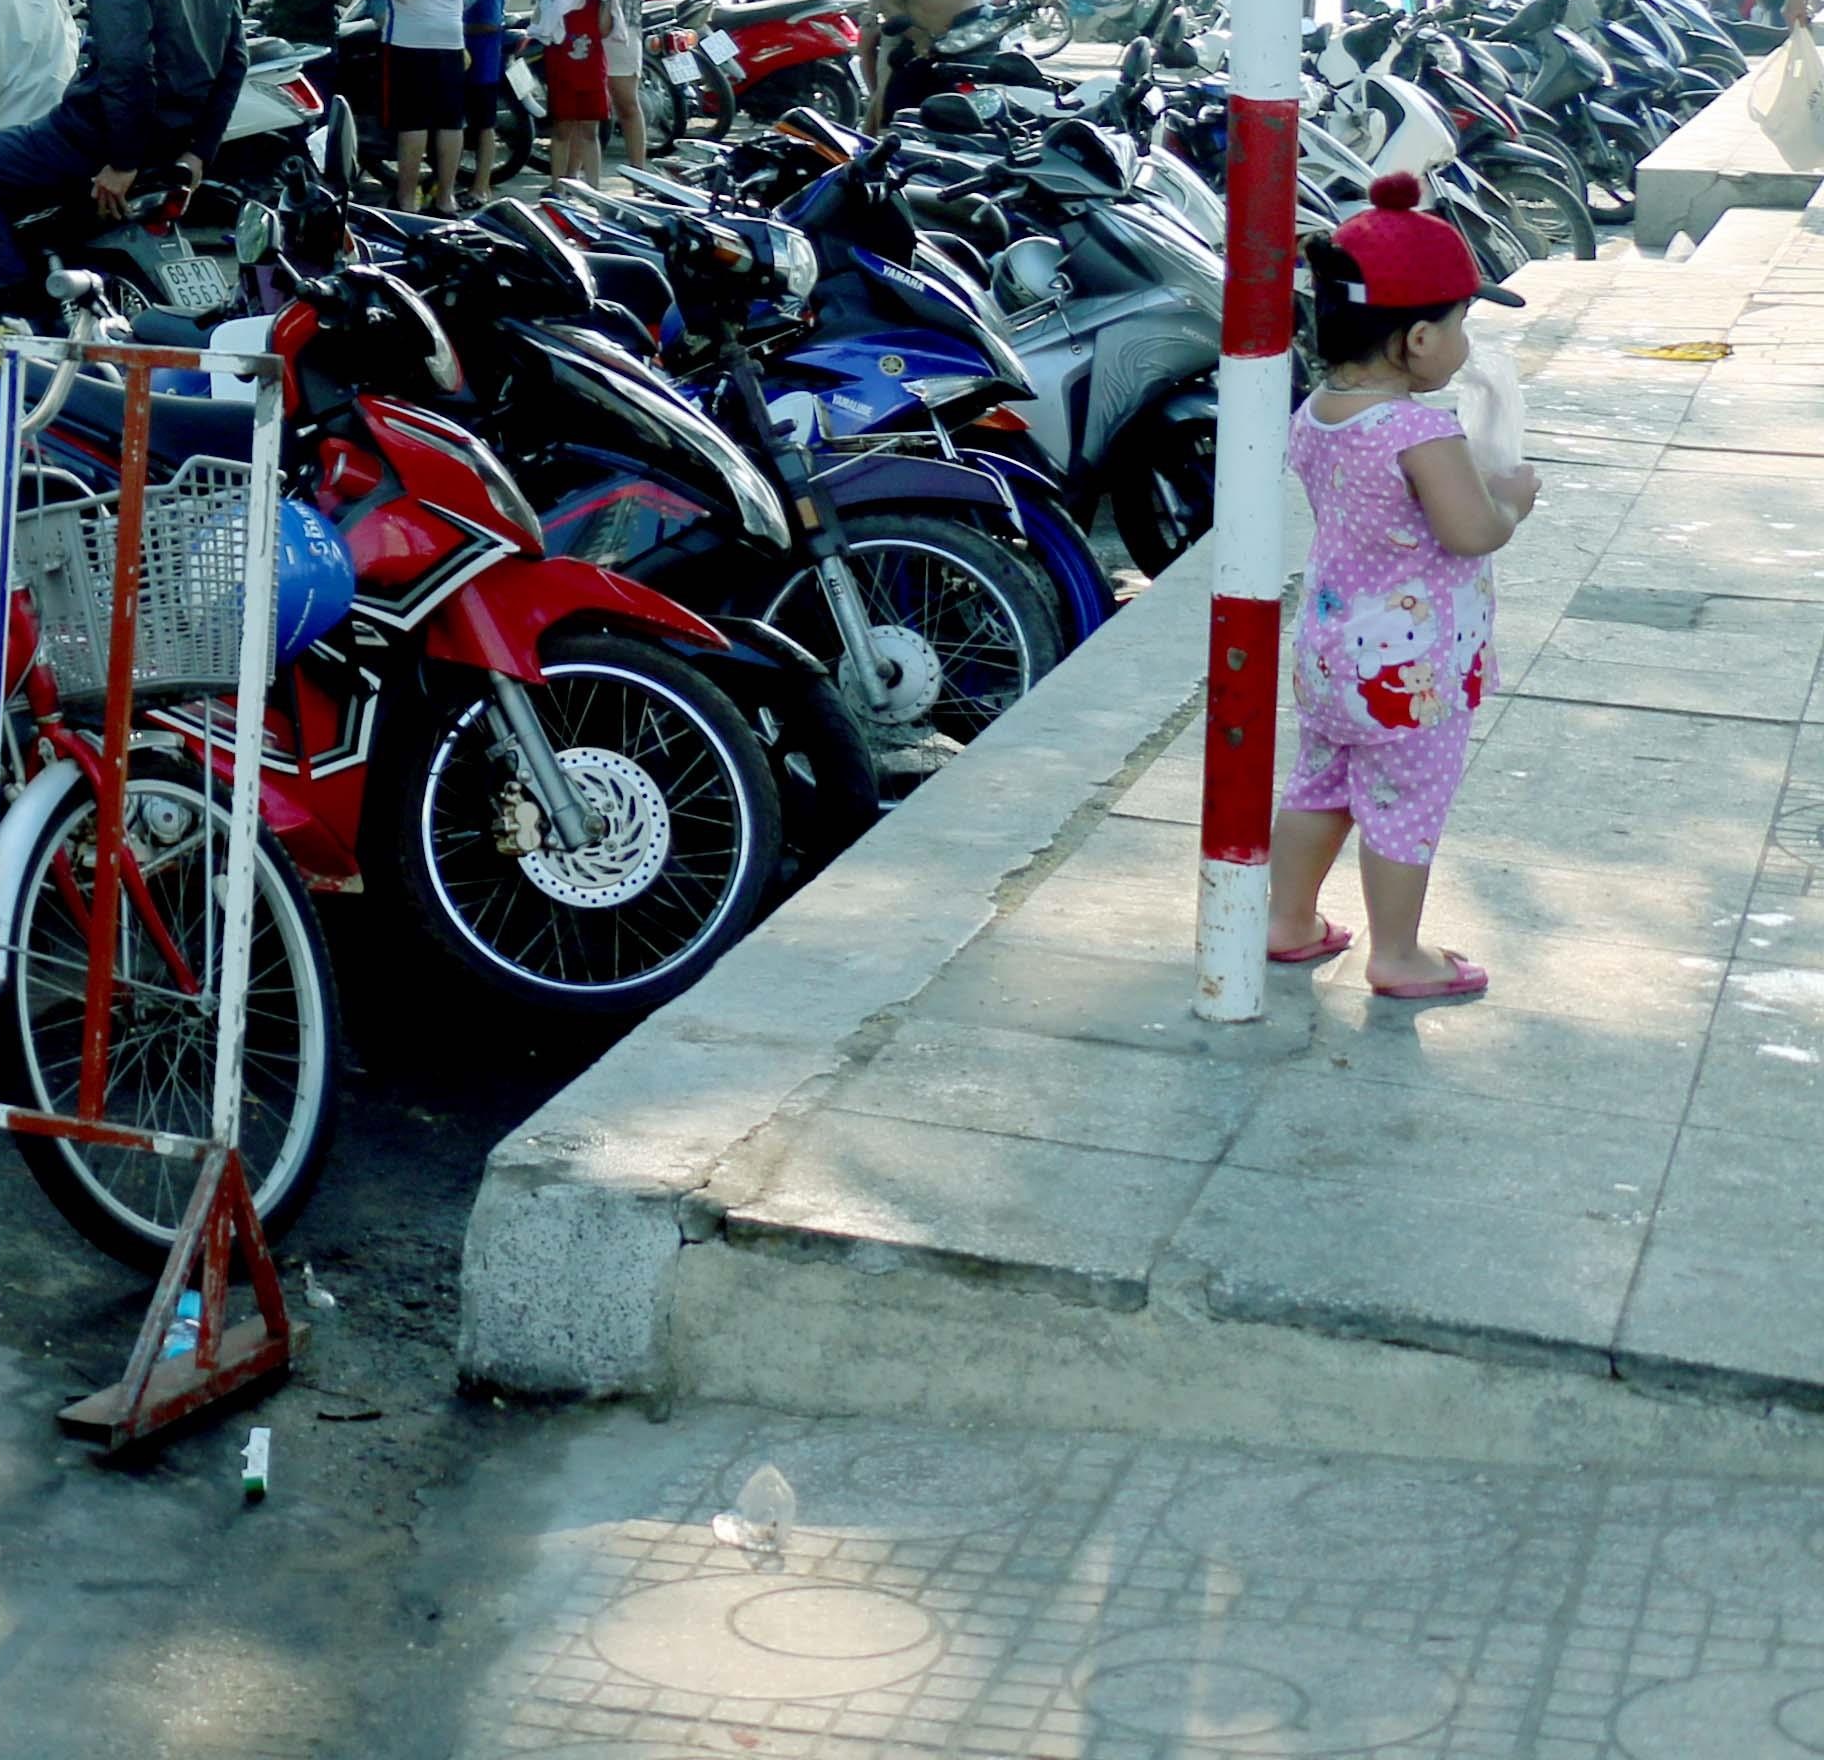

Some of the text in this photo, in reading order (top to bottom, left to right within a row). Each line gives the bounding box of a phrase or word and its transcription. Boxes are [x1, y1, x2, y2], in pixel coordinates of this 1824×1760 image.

[166, 261, 213, 285] 69-R1
[881, 264, 925, 293] YAMAHA
[177, 283, 224, 307] 6563
